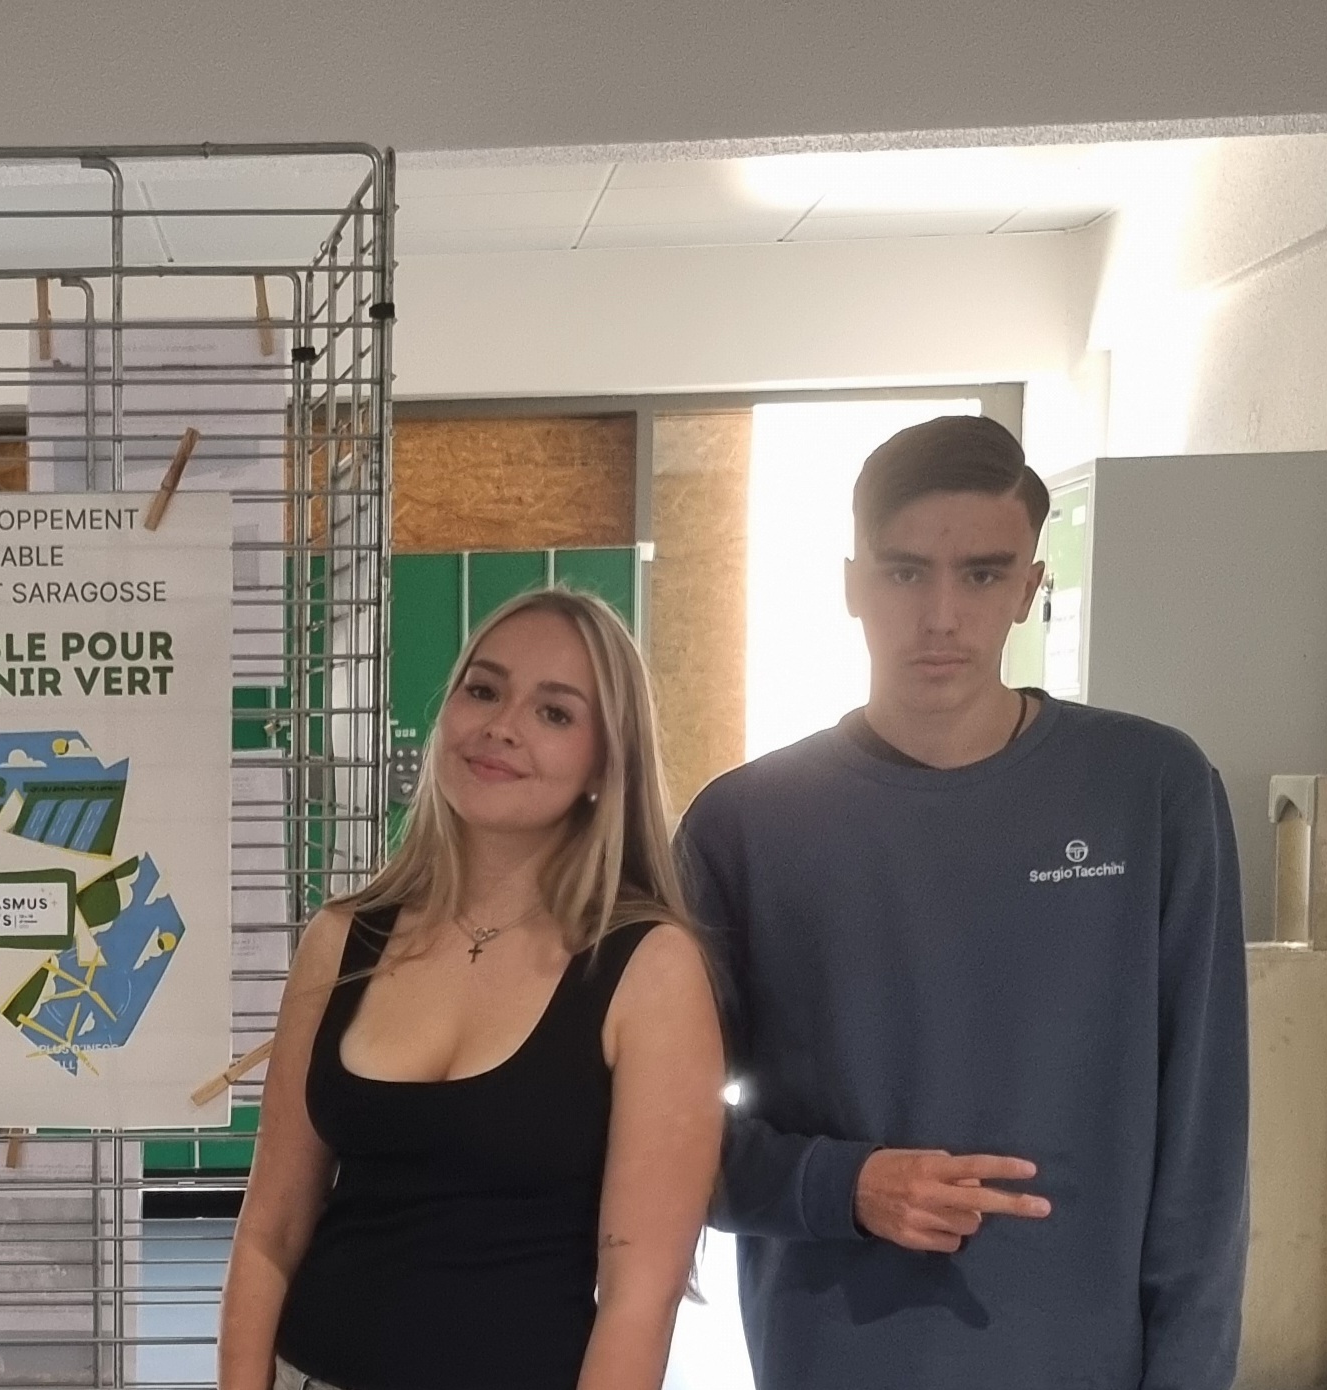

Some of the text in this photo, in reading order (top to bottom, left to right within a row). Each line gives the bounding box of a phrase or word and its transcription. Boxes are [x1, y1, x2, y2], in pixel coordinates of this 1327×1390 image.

[12, 580, 168, 605] SARAGOSSE
[61, 631, 174, 662] POUR
[73, 665, 174, 696] VERT
[1029, 861, 1126, 883] Sergio Tacchini
